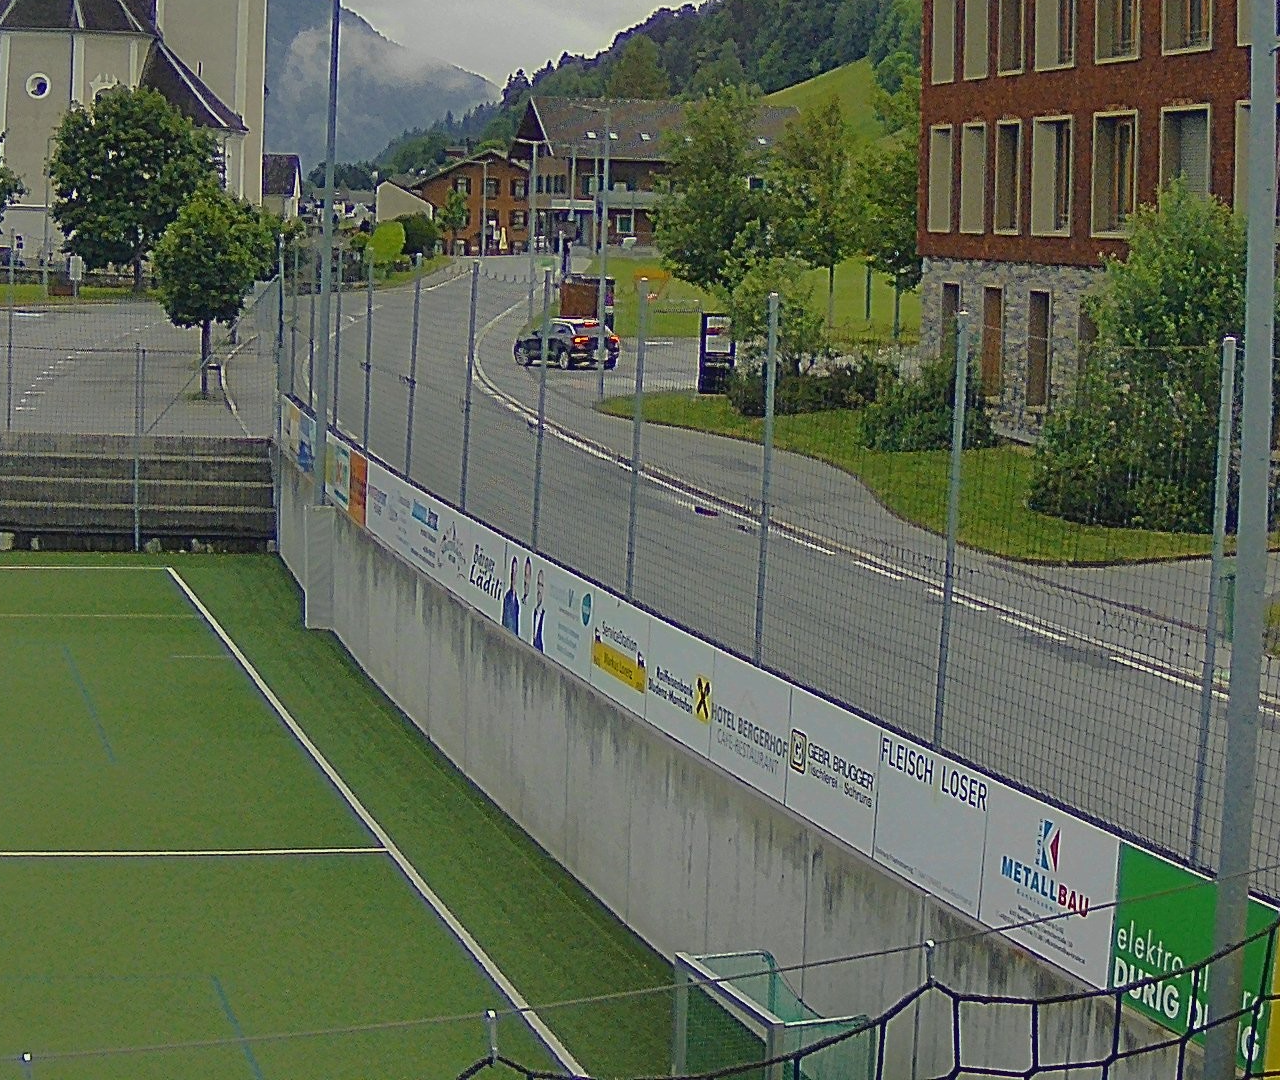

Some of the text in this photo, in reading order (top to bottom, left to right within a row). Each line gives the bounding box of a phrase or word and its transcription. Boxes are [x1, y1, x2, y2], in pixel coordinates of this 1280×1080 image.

[711, 703, 736, 731] HOTEL
[737, 717, 788, 758] BERGERHOF
[832, 755, 875, 791] BRUGGER
[881, 737, 988, 812] FLEISCH LOSER
[1001, 855, 1089, 918] METALLBAU
[1116, 920, 1183, 979] elektro
